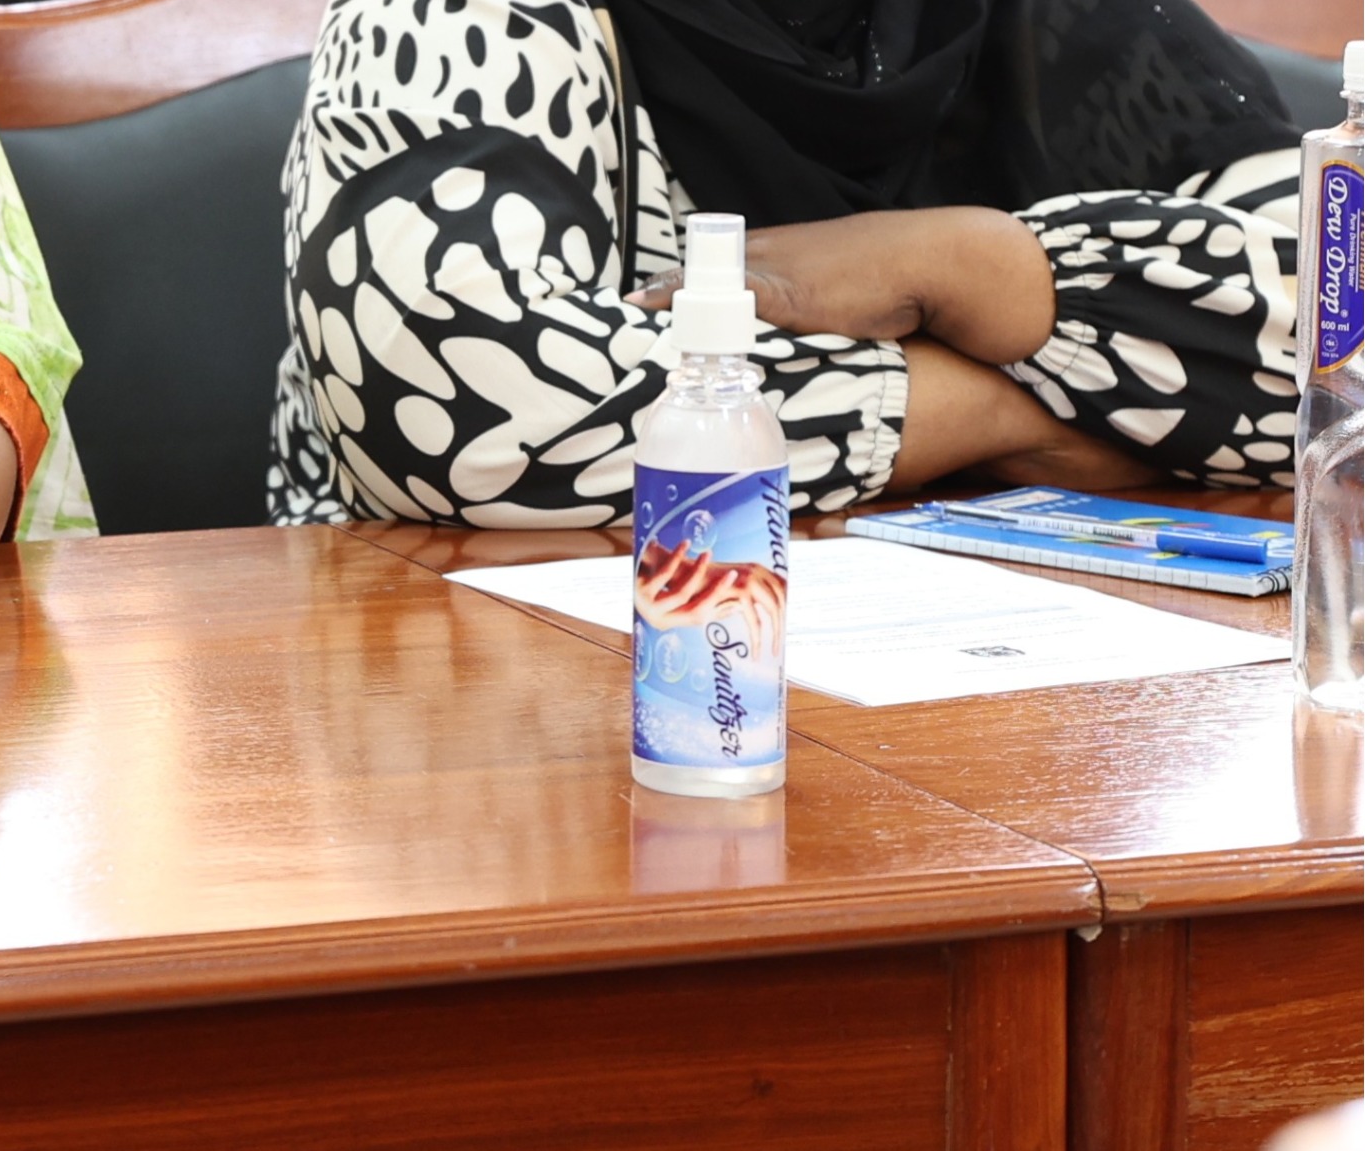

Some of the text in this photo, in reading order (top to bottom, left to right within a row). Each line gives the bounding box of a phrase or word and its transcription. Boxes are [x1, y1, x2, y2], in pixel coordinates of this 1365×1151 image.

[1319, 176, 1348, 314] Dew Drop
[1320, 320, 1350, 332] 600 ml
[706, 621, 749, 758] Sanitizer
